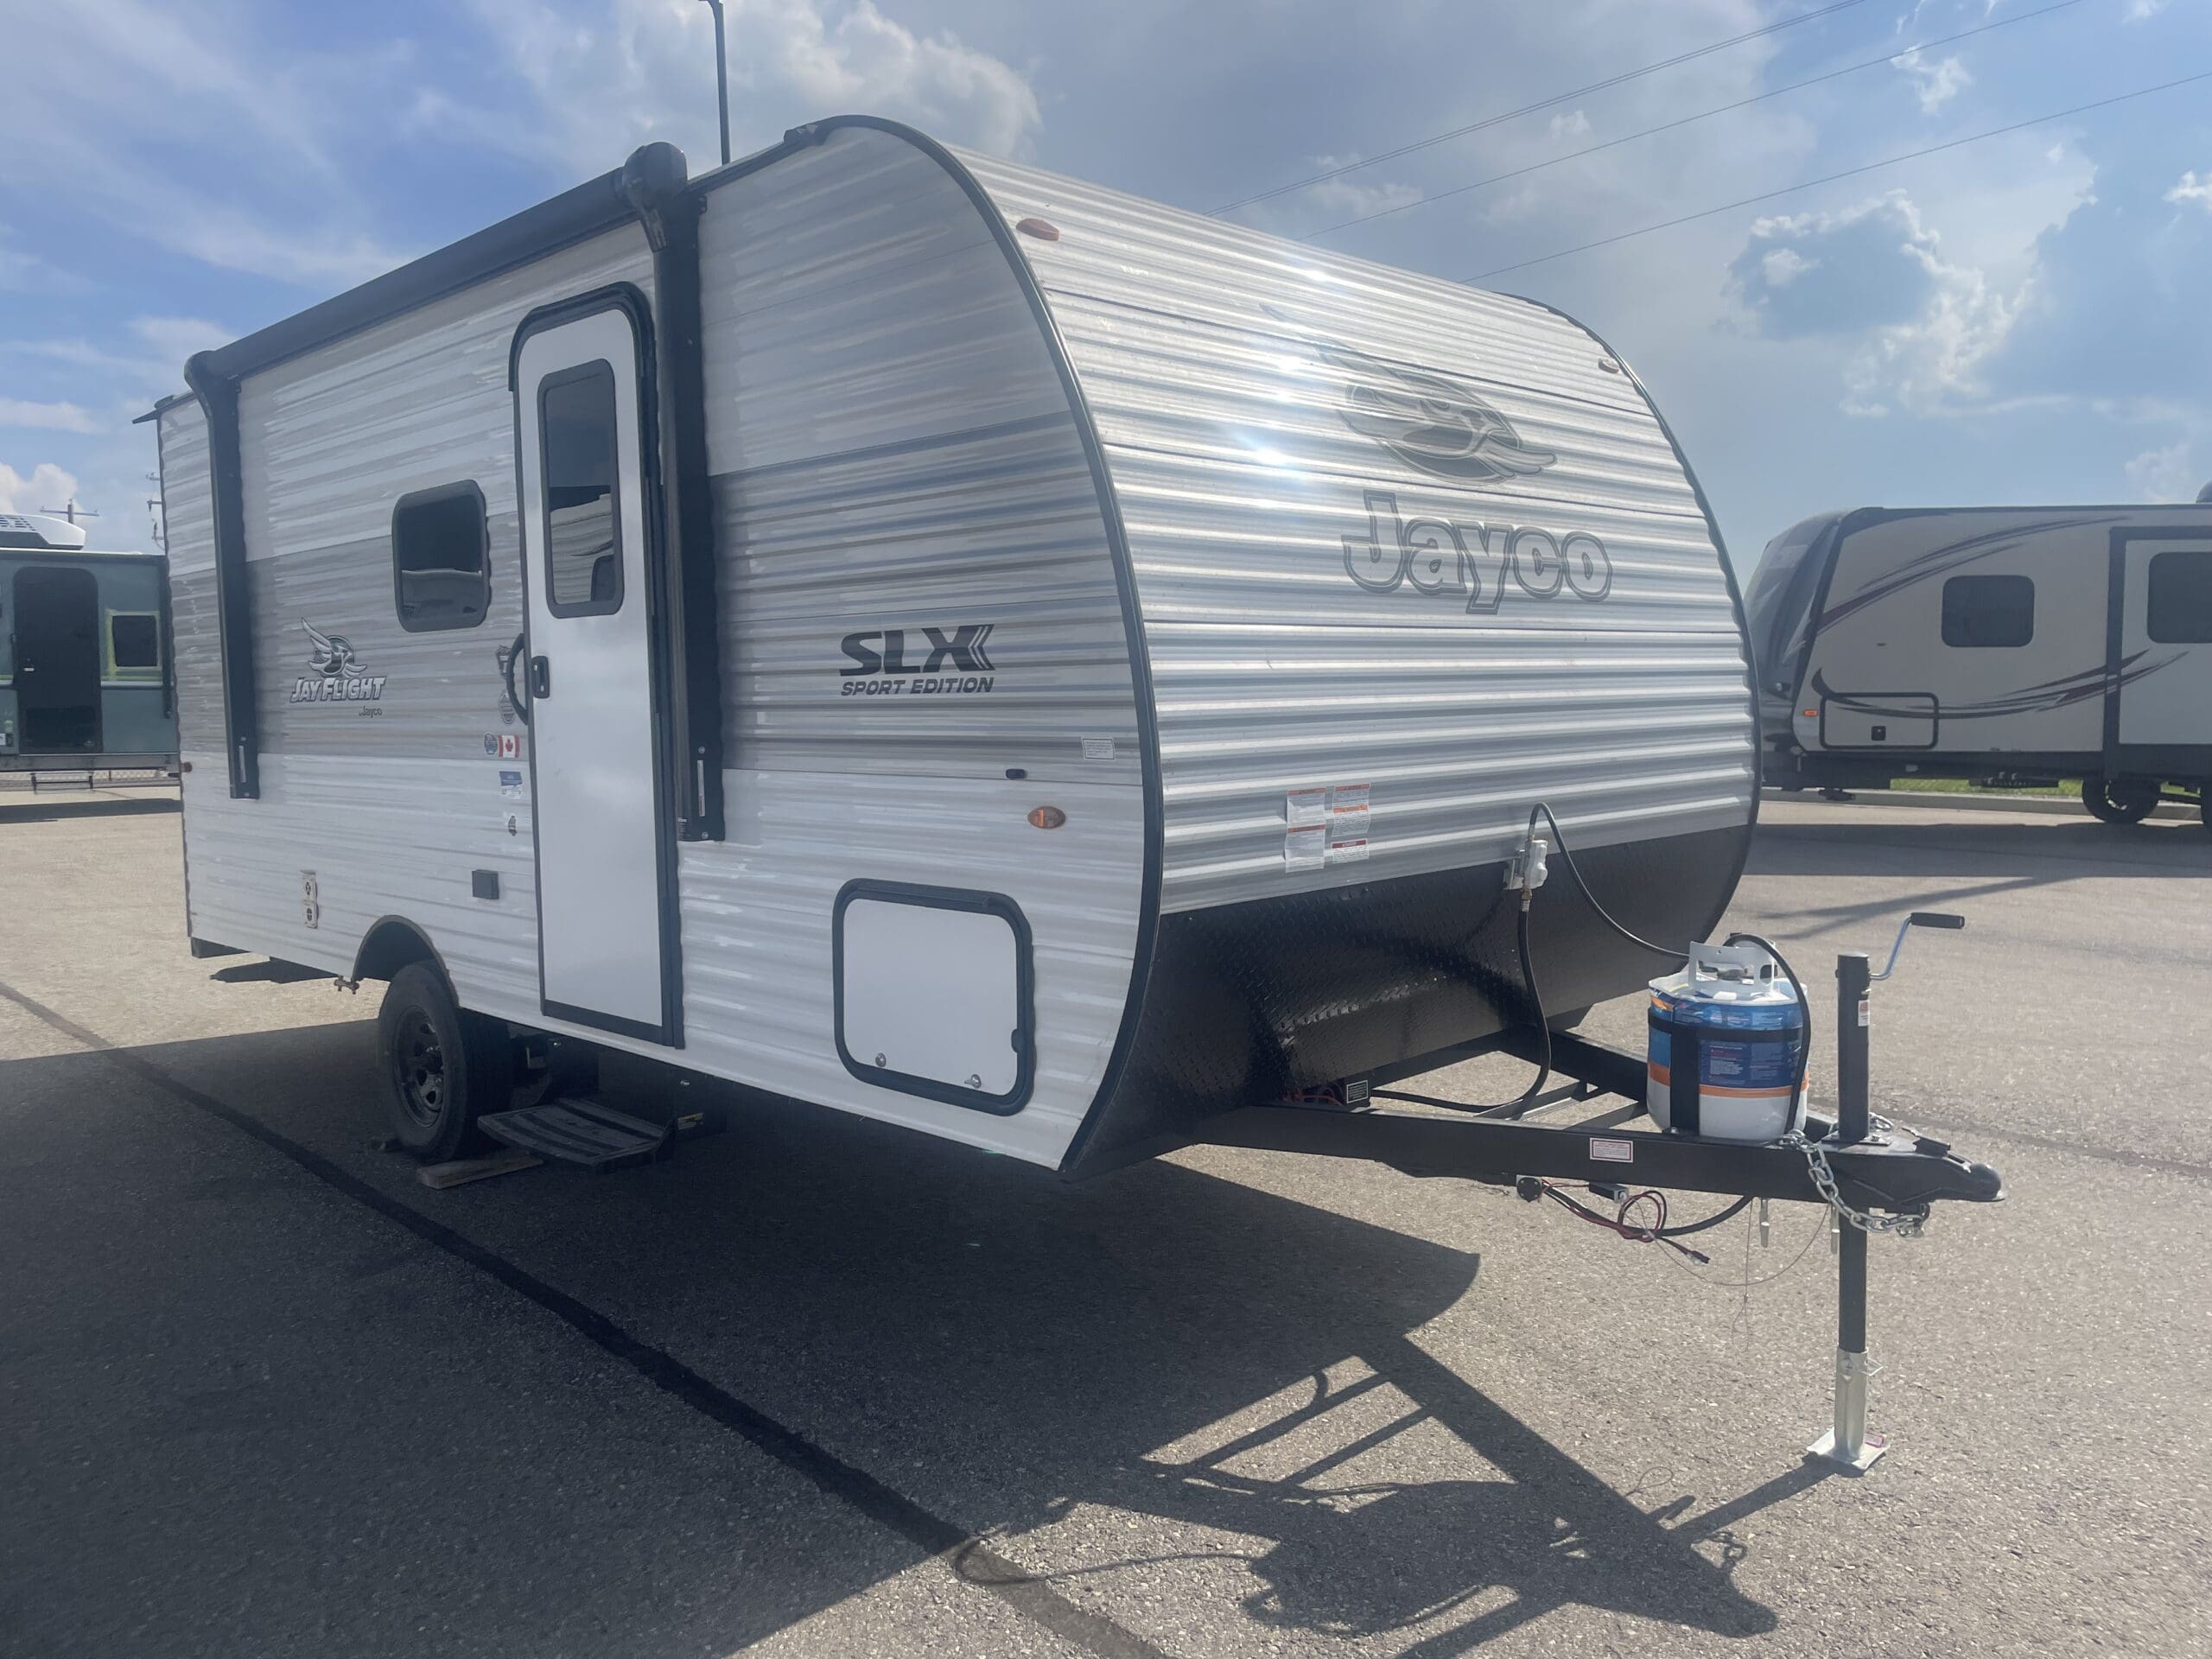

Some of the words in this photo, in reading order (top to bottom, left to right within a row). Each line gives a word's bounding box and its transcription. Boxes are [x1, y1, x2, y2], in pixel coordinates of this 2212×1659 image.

[1341, 489, 1612, 614] Jayco
[840, 624, 995, 676] SLX
[841, 679, 906, 696] SPORT
[910, 677, 994, 694] EDITION
[359, 706, 383, 718] Jayco
